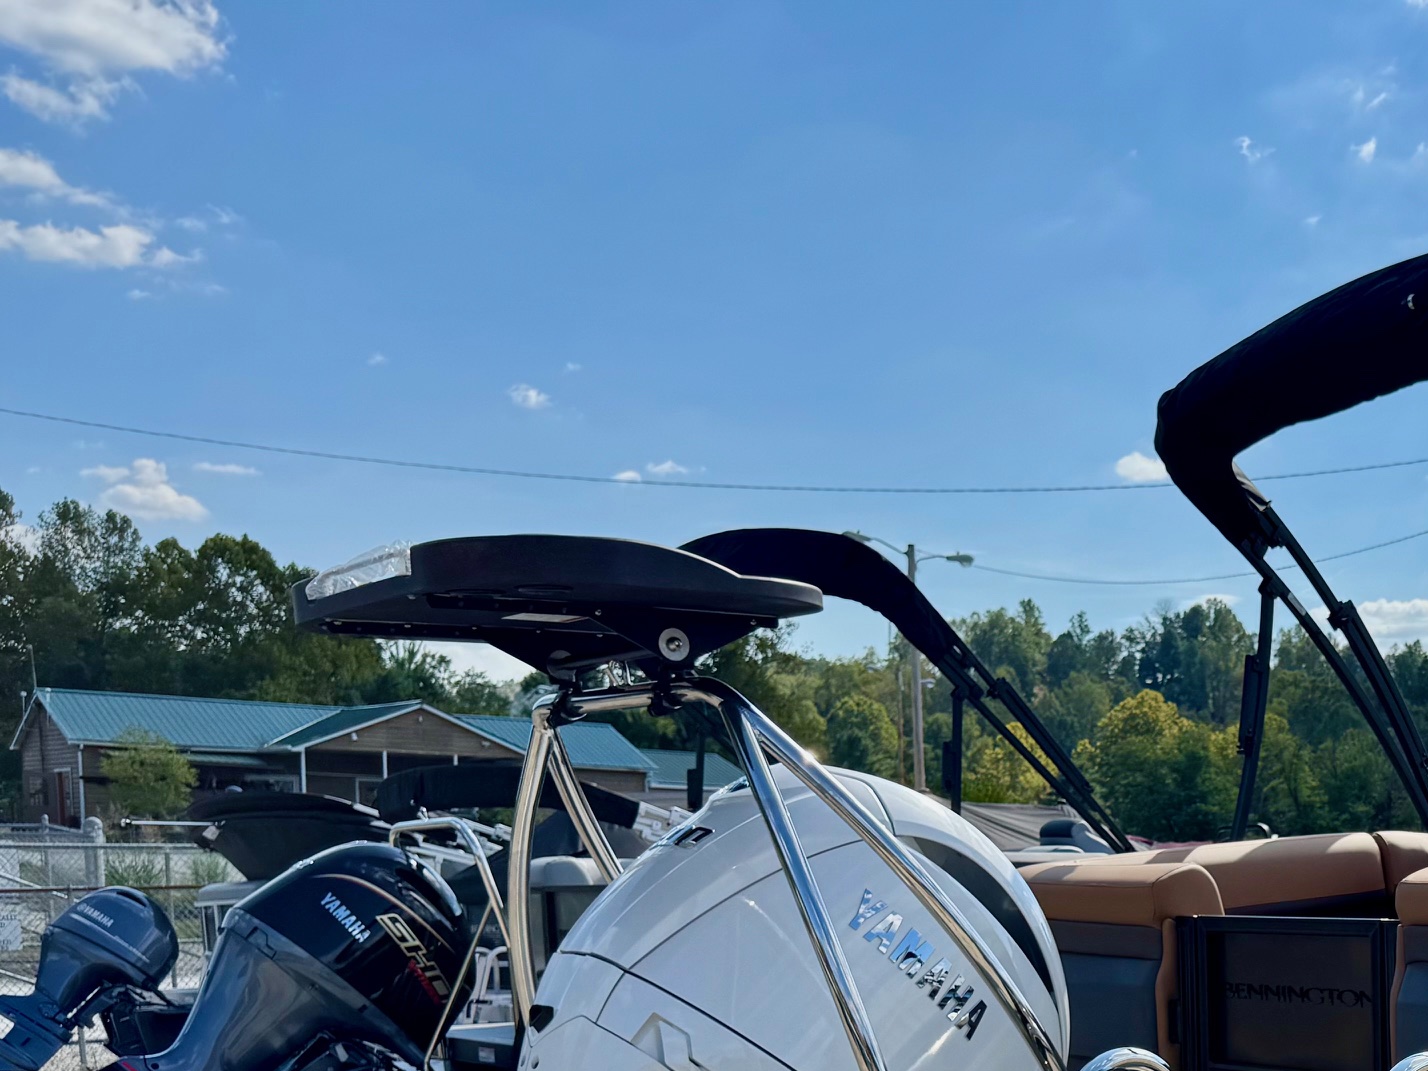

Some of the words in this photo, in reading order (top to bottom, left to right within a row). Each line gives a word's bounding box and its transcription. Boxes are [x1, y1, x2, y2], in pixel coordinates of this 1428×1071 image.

[83, 905, 114, 928] YAMAHA
[320, 892, 371, 943] YAMAHA
[848, 888, 988, 1041] YAMAHA
